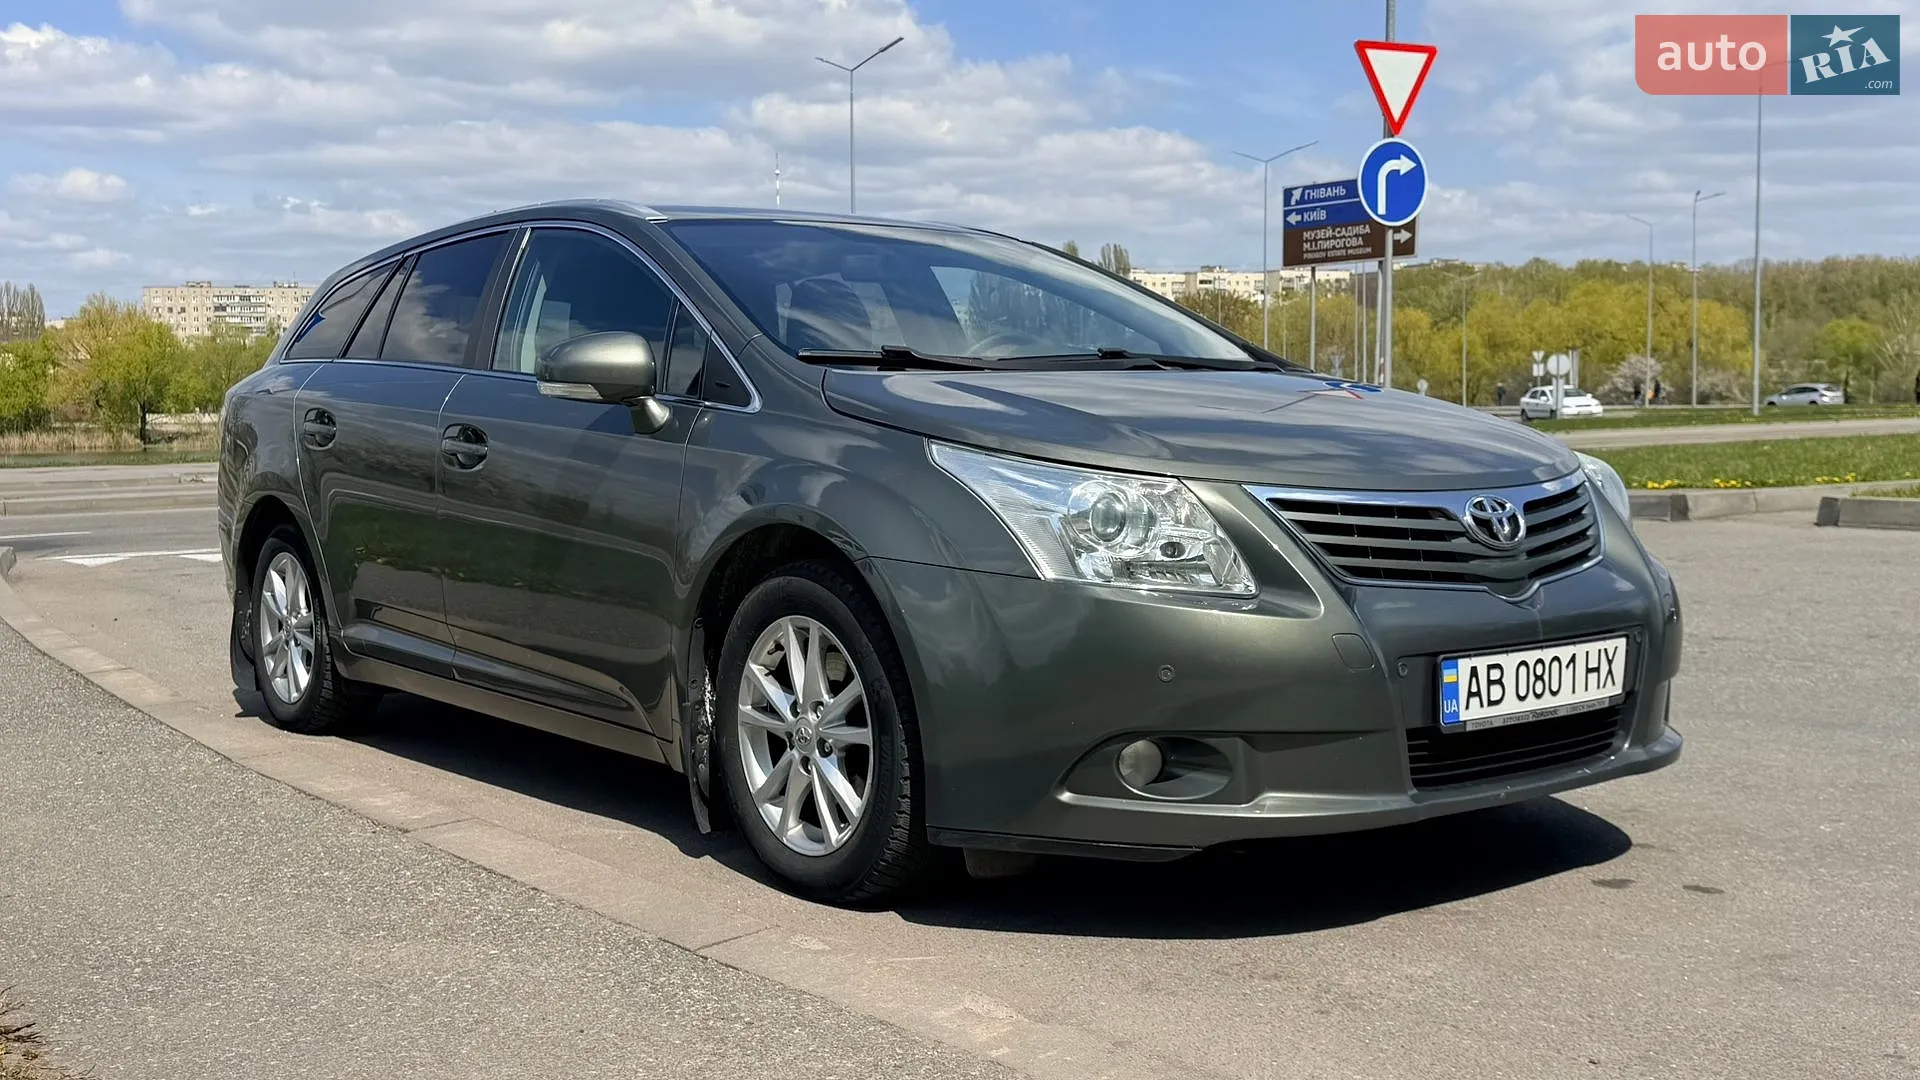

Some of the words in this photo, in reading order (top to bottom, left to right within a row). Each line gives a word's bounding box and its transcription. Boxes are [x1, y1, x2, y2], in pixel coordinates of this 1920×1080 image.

[1304, 186, 1346, 201] ГНІВАНЬ
[1303, 208, 1327, 223] КИЇВ
[1303, 224, 1371, 241] МУЗЕЙ-САДИБА
[1465, 663, 1506, 711] AB
[1515, 653, 1577, 702] 0801
[1584, 646, 1619, 692] HX
[1443, 701, 1459, 713] UA
